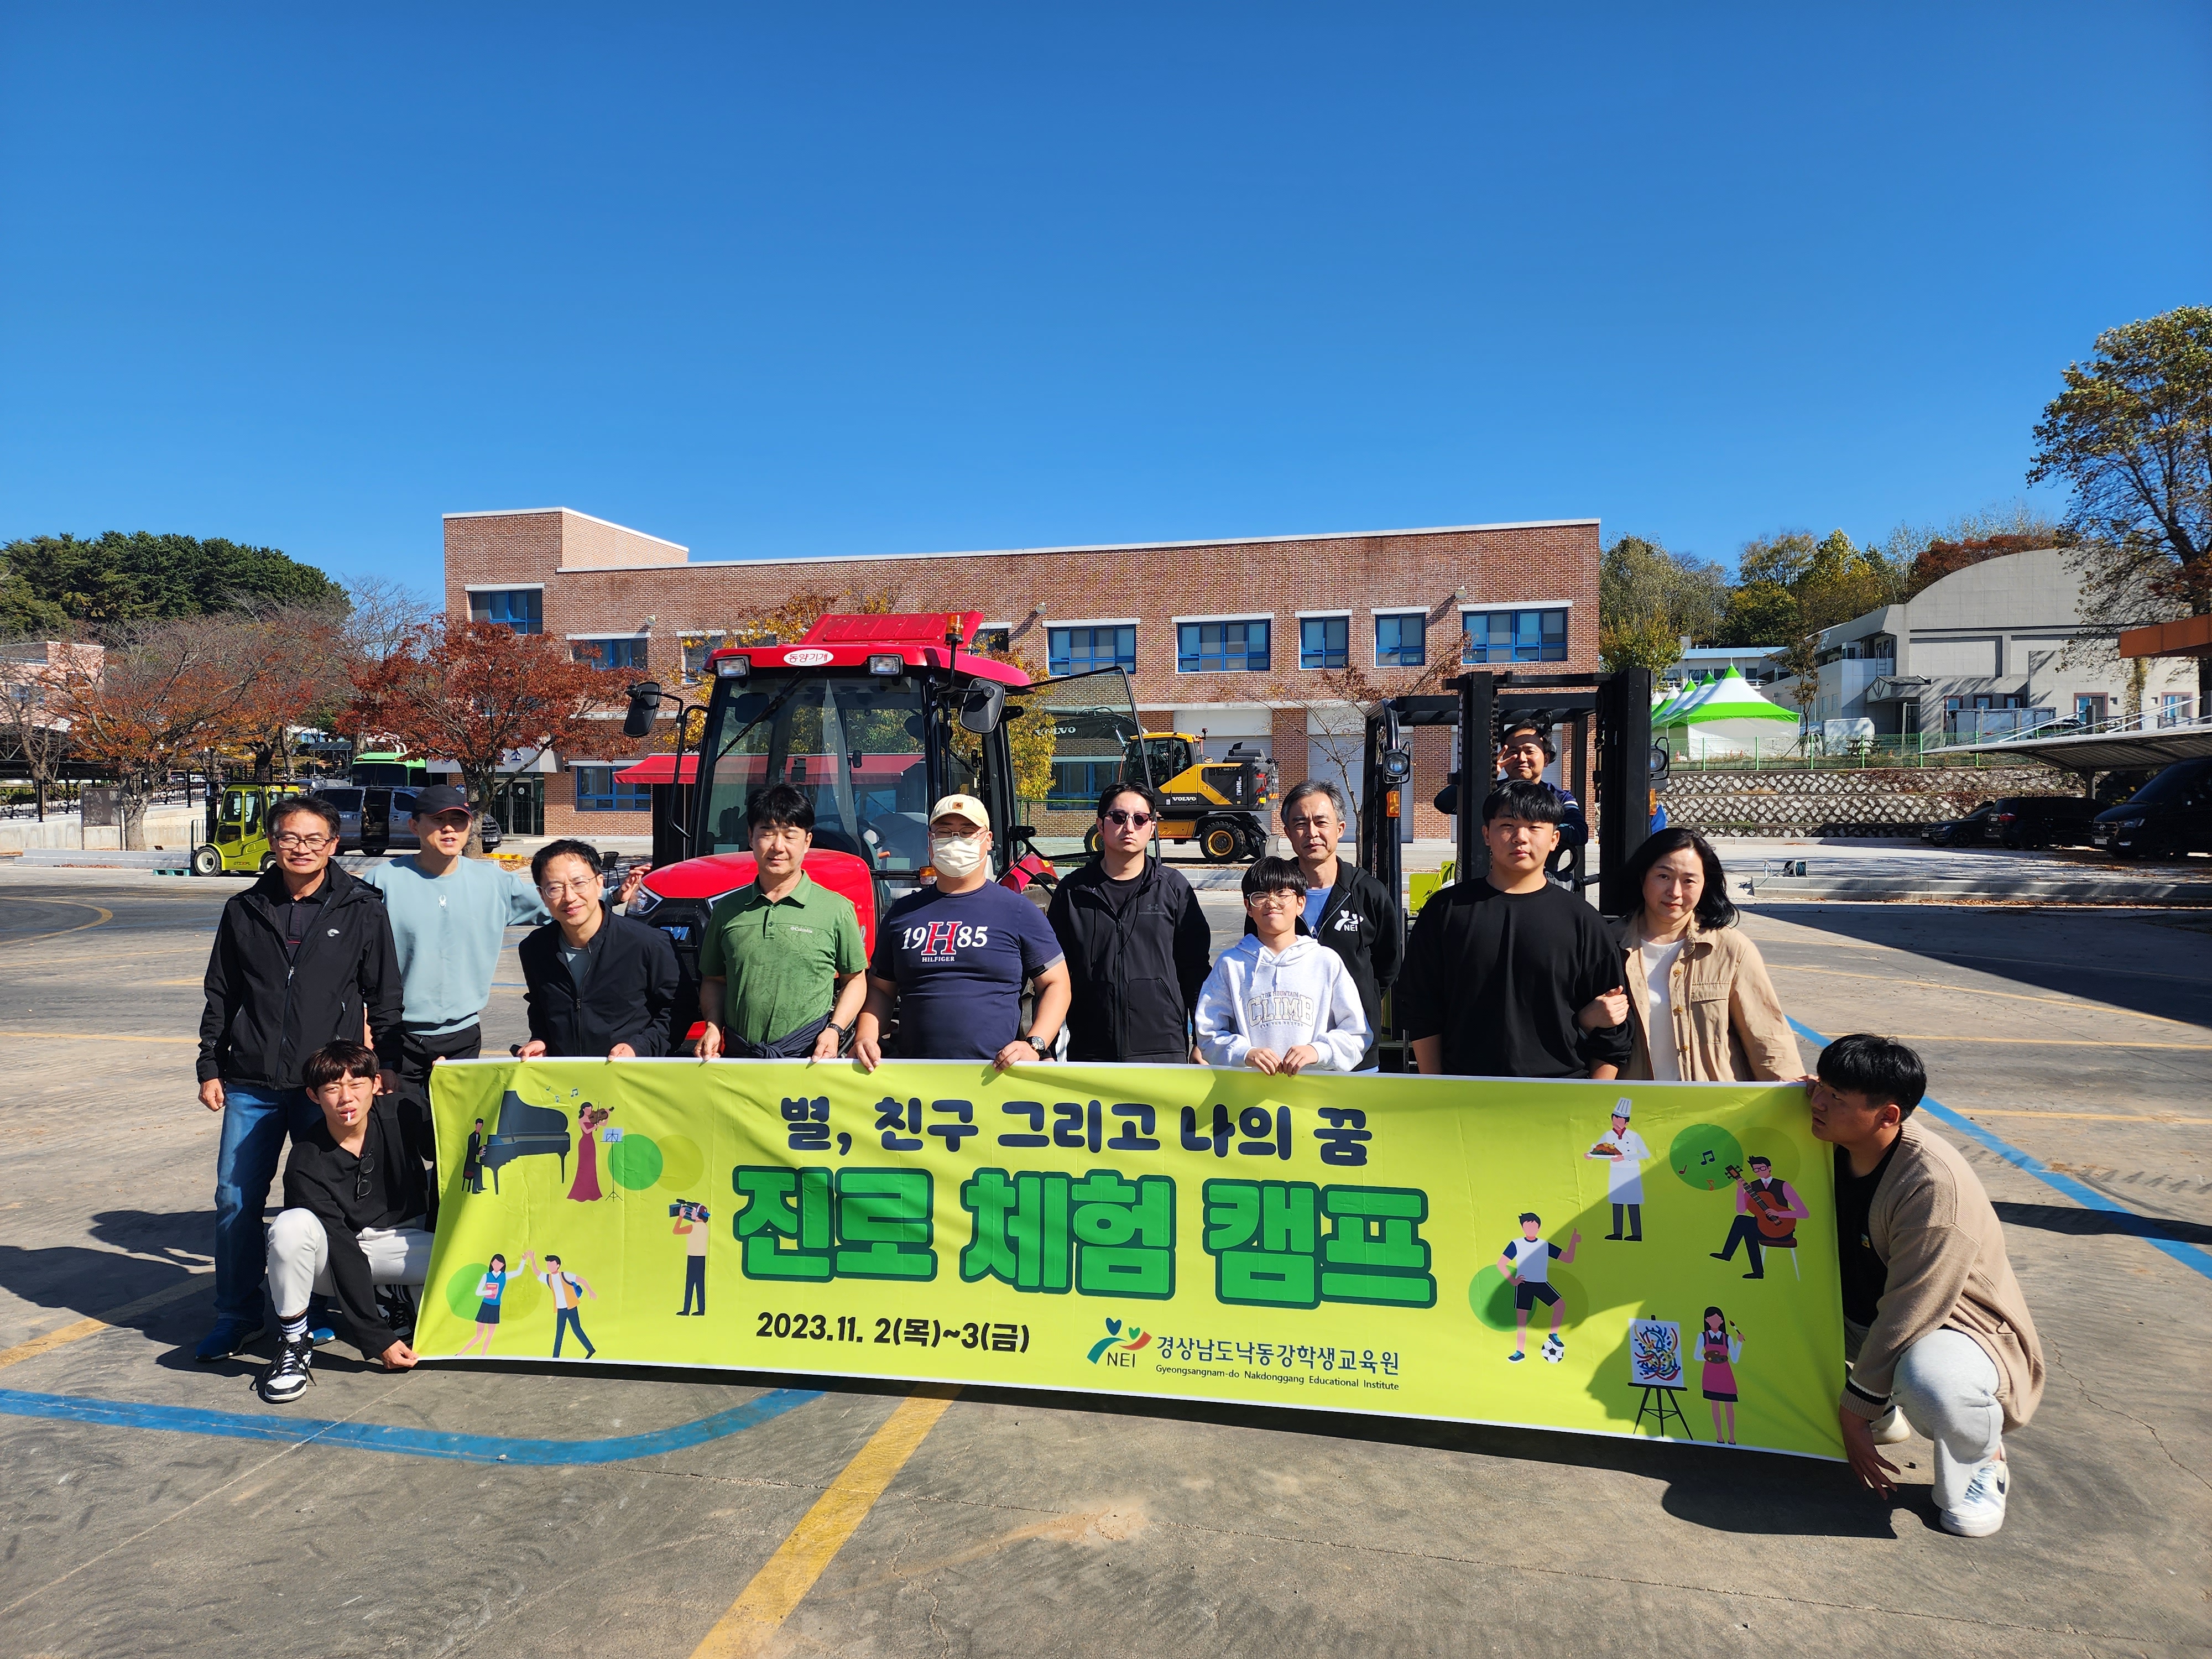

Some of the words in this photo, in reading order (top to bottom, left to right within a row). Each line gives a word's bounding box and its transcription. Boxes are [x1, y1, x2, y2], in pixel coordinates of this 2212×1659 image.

[789, 653, 828, 663] 동양기계
[1247, 994, 1314, 1027] CLIMB
[781, 1096, 852, 1156] 별,
[874, 1096, 979, 1152] 친구
[997, 1099, 1160, 1154] 그리고
[1181, 1104, 1292, 1161] 나의
[1313, 1107, 1373, 1166] 꿈
[732, 1165, 938, 1283] 진로
[959, 1167, 1176, 1301] 체험
[1202, 1178, 1437, 1310] 캠프
[756, 1312, 863, 1343] 2023.11.
[874, 1317, 1030, 1354] 2(목)~3(금)
[1107, 1352, 1135, 1368] NEI
[1156, 1336, 1399, 1376] 경상남도낙동강학생교육원
[1156, 1364, 1240, 1378] Gyeongsangnam-do
[1244, 1370, 1305, 1385] Nakdonggang
[1309, 1375, 1359, 1387] Educational
[1364, 1379, 1399, 1390] Institute
